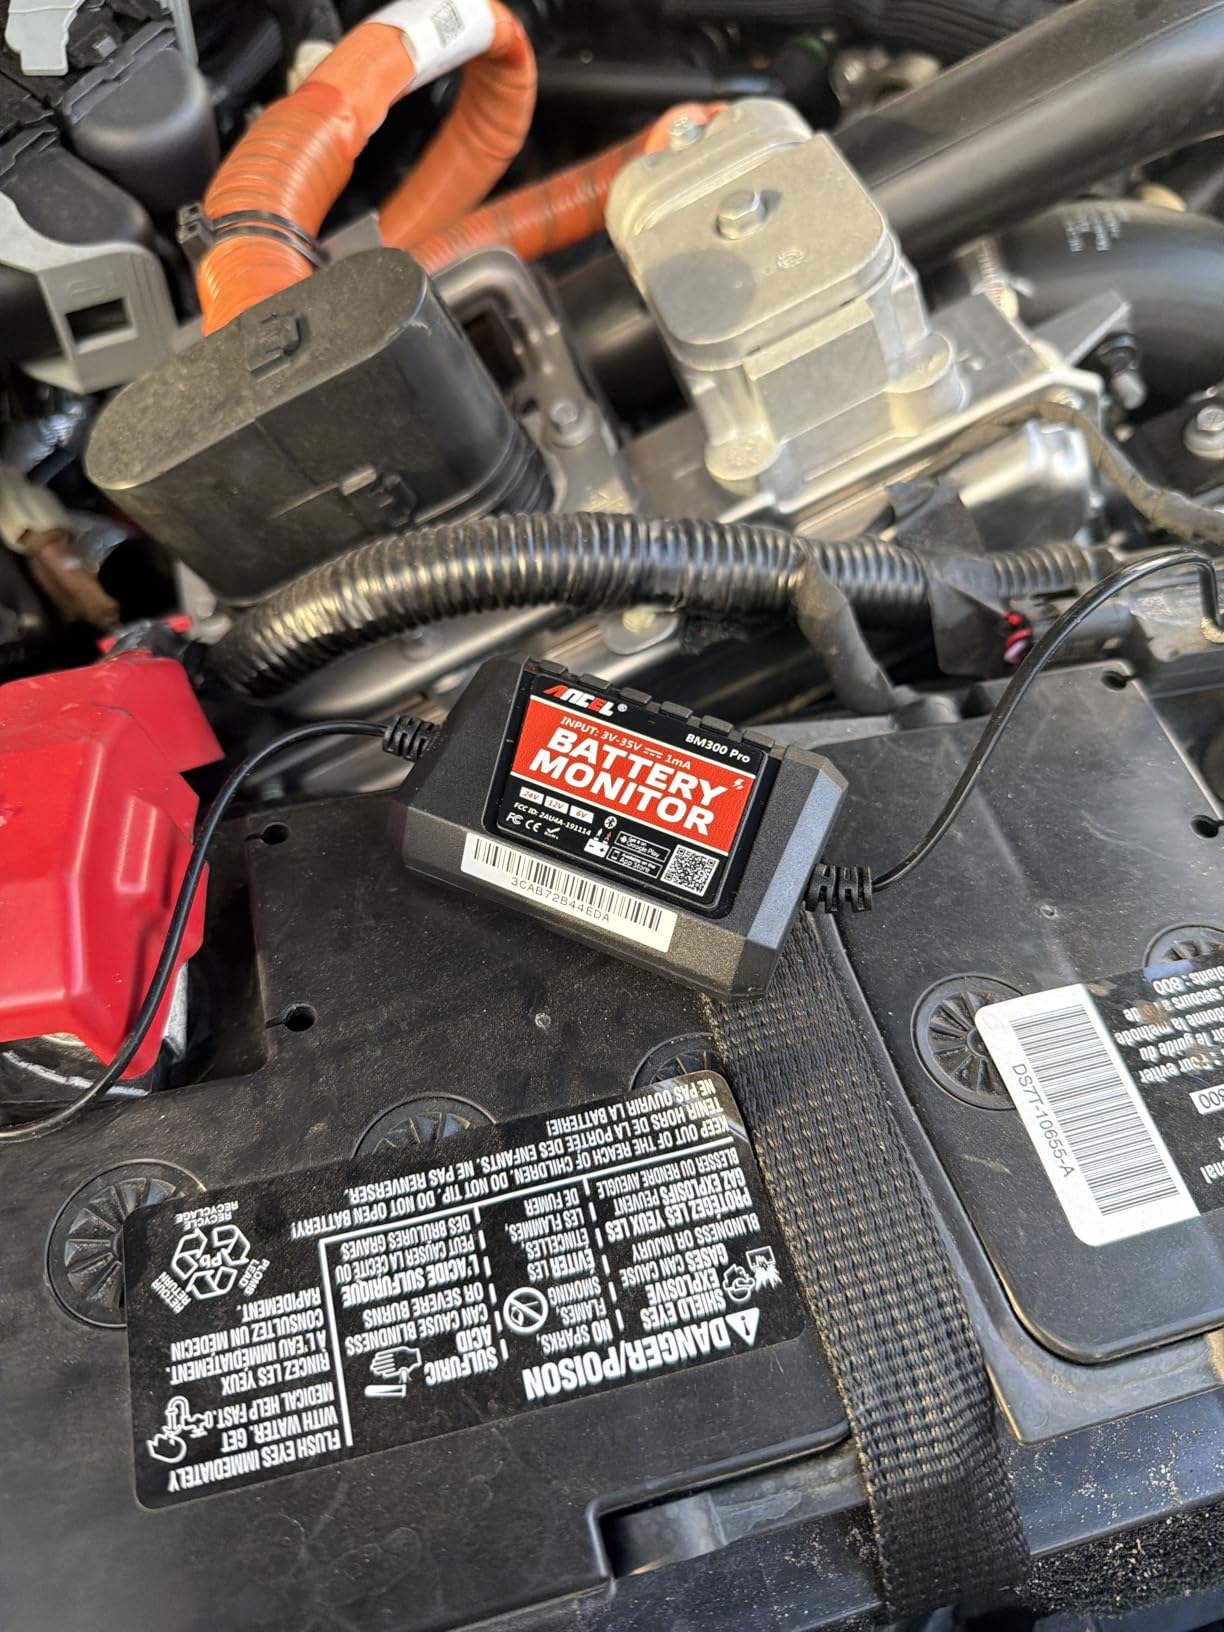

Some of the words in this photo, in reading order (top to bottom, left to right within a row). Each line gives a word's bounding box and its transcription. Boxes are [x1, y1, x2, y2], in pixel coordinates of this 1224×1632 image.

[560, 716, 599, 736] INPUT:
[600, 731, 643, 751] 3V-35V
[665, 754, 691, 770] 1mA
[685, 733, 728, 755] BM300
[729, 748, 750, 763] Pro
[547, 727, 728, 806] BATTERY
[529, 748, 714, 836] MONITOR
[514, 802, 528, 812] FCC
[626, 840, 647, 853] Google
[647, 848, 660, 859] Play
[618, 857, 633, 868] App
[633, 861, 650, 873] Store
[673, 1082, 699, 1104] PAS
[697, 1078, 716, 1097] NE
[607, 1103, 626, 1121] LA
[626, 1089, 673, 1116] OUVRIR
[685, 1097, 724, 1120] TENIR
[546, 1107, 608, 1137] BATTERIE!
[614, 1121, 631, 1140] LA
[631, 1117, 650, 1135] DE
[650, 1106, 686, 1130] HORS
[700, 1114, 730, 1138] KEEP
[1011, 1063, 1075, 1178] DS7T-10655-A
[565, 1126, 614, 1153] PORTÉE
[632, 1136, 657, 1155] THE
[657, 1131, 673, 1149] OF
[675, 1124, 699, 1145] OUT
[476, 1144, 537, 1174] ENFANTS.
[538, 1138, 564, 1158] DES
[576, 1152, 591, 1170] OF
[592, 1141, 632, 1165] REACH
[695, 1147, 739, 1173] BLESSER
[428, 1165, 455, 1187] PAS
[456, 1160, 474, 1180] NE
[510, 1156, 573, 1185] CHILDREN.
[640, 1162, 681, 1187] RENDRE
[680, 1159, 696, 1178] OU
[720, 1167, 746, 1190] GAZ
[344, 1172, 427, 1205] RENVERSER.
[437, 1184, 463, 1204] TIP.
[464, 1177, 489, 1199] NOT
[490, 1172, 509, 1192] DO
[596, 1172, 640, 1199] AVEUGLE
[659, 1173, 722, 1206] EXPLOSIFS
[390, 1195, 415, 1218] NOT
[417, 1190, 436, 1210] DO
[524, 1192, 563, 1217] FUMER
[563, 1188, 580, 1207] DE
[613, 1188, 660, 1216] PEUVENT
[688, 1186, 753, 1221] PROTÉGEZ
[175, 1201, 238, 1224] RECYCLAGE
[184, 1211, 232, 1231] RECYCLE
[291, 1209, 352, 1240] BATTERY!
[353, 1202, 387, 1225] OPEN
[448, 1214, 471, 1236] DES
[563, 1208, 585, 1229] LES
[629, 1209, 666, 1236] YEUX
[665, 1202, 690, 1226] LES
[387, 1220, 447, 1251] BRÛLURES
[505, 1213, 563, 1243] FLAMMES,
[605, 1217, 630, 1242] LES
[674, 1230, 694, 1250] OR
[694, 1213, 760, 1245] BLINDNESS
[340, 1234, 386, 1262] GRAVES
[405, 1241, 447, 1267] CAUSER
[448, 1233, 475, 1257] PEUT
[521, 1227, 590, 1261] ÉTINCELLES,
[632, 1235, 675, 1262] INJURY
[196, 1251, 222, 1268] Pb
[389, 1251, 405, 1271] LA
[425, 1254, 480, 1287] L'ACIDE
[527, 1259, 549, 1282] LES
[549, 1248, 596, 1278] ÉVITER
[659, 1254, 685, 1277] CAN
[685, 1243, 728, 1272] GASES
[239, 1259, 260, 1287] LEAD
[244, 1259, 270, 1295] PLOMB
[335, 1263, 352, 1284] OU
[619, 1261, 659, 1287] CAUSE
[645, 1267, 720, 1305] EXPLOSIVE
[151, 1279, 184, 1313] RETOUR
[159, 1272, 191, 1306] RETURN
[341, 1267, 425, 1308] SULFURIQUE
[463, 1282, 484, 1303] OR
[547, 1276, 601, 1306] SMOKING
[237, 1287, 321, 1323] RAPIDEMENT.
[363, 1300, 410, 1329] BURNS
[411, 1287, 462, 1317] SEVERE
[461, 1303, 488, 1327] CAN
[556, 1297, 607, 1326] FLAMES,
[677, 1288, 726, 1320] SHIELD
[251, 1308, 324, 1343] CONSULTEZ
[418, 1310, 460, 1338] CAUSE
[640, 1301, 678, 1330] EYES
[230, 1326, 250, 1347] UN
[345, 1321, 417, 1356] BLINDNESS
[456, 1324, 492, 1353] ACID
[536, 1324, 591, 1355] SPARKS,
[591, 1318, 613, 1344] NO
[170, 1330, 229, 1362] MÉDECIN
[278, 1332, 316, 1359] L'EAU
[522, 1317, 731, 1400] DANGER/POISON
[165, 1342, 277, 1385] IMMÉDIATEMENT.
[257, 1363, 282, 1387] LES
[283, 1350, 330, 1381] RINCEZ
[424, 1347, 498, 1385] SULFURIC
[221, 1370, 256, 1396] YEUX
[249, 1395, 281, 1420] HELP
[280, 1382, 334, 1411] MEDICAL
[249, 1415, 302, 1444] WATER.
[302, 1405, 338, 1431] WITH
[221, 1428, 247, 1453] GET
[261, 1440, 296, 1467] EYES
[296, 1429, 341, 1458] FLUSH
[168, 1449, 260, 1492] IMMEDIATELY
